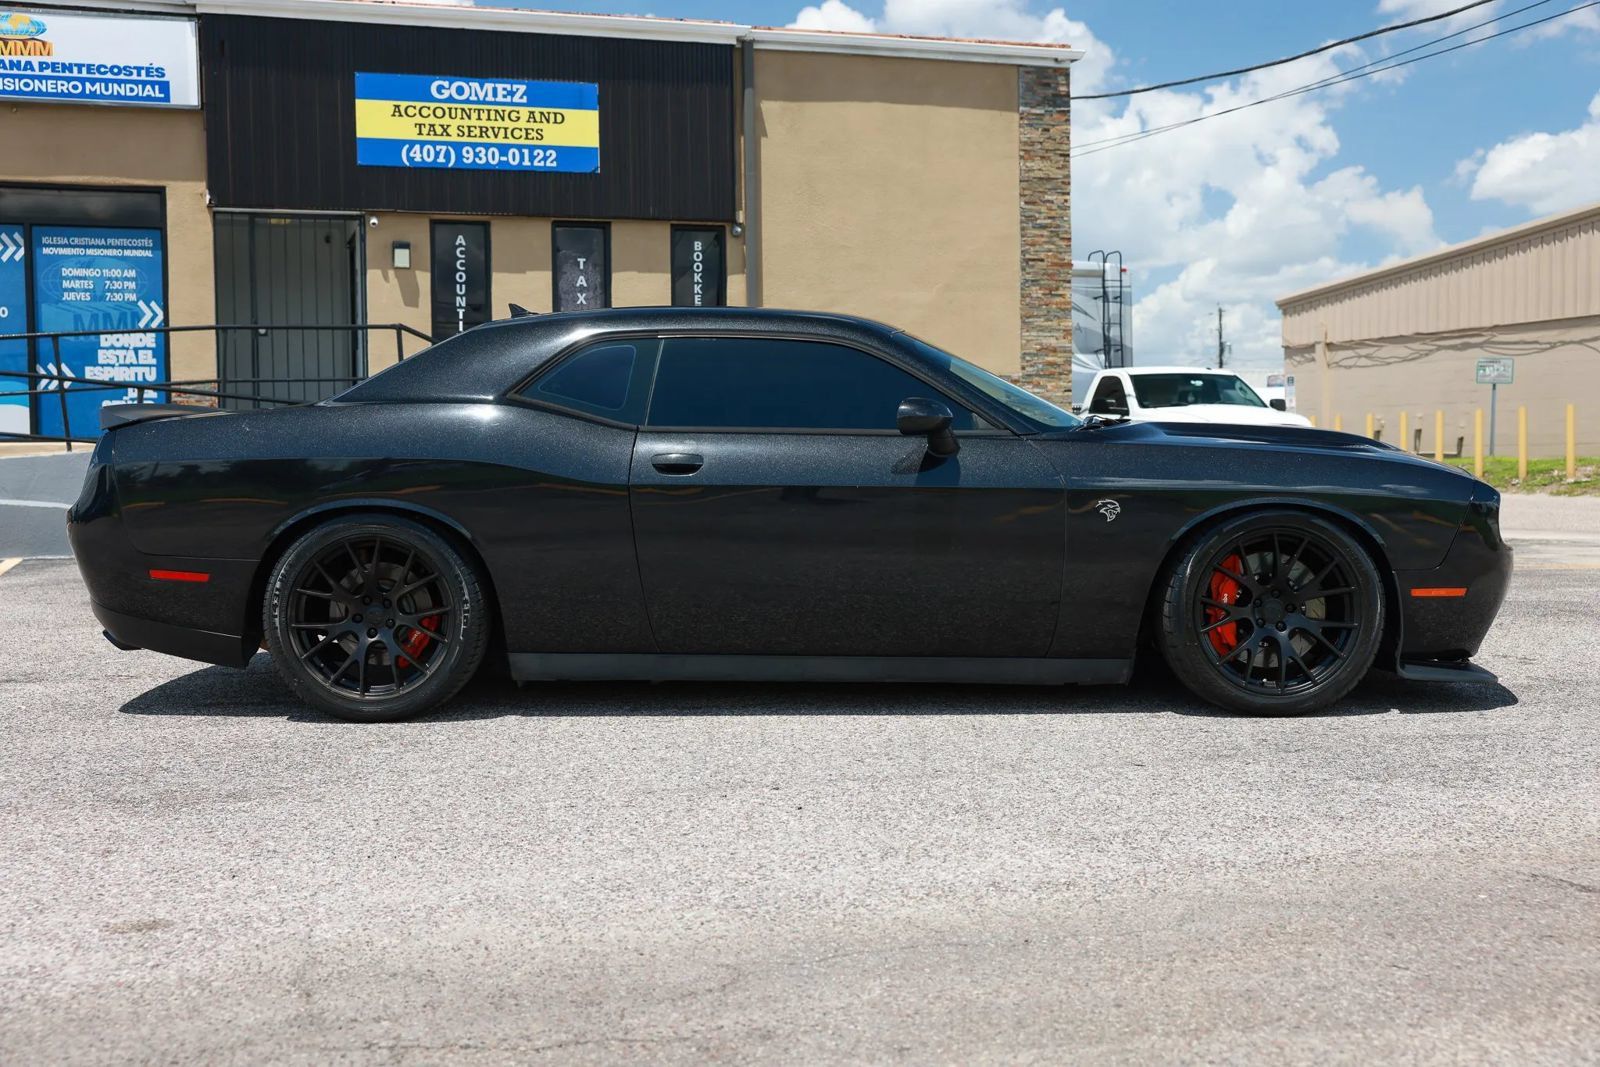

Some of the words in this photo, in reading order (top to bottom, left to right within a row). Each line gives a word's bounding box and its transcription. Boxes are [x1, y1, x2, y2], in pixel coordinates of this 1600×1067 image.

[38, 61, 166, 78] PENTECOSTÉS
[85, 82, 165, 98] MUNDIAL
[430, 80, 528, 103] GOMEZ
[391, 104, 521, 123] ACCOUNTING
[526, 110, 565, 125] AND
[414, 123, 452, 137] TAX
[456, 125, 545, 142] SERVICES
[400, 144, 456, 168] (407)
[462, 146, 557, 167] 930-0122
[42, 237, 69, 246] IGLESIA
[69, 238, 106, 246] CRISTIANA
[107, 238, 153, 247] PENTECOSTÉS
[42, 247, 85, 256] MOVIMIENTO
[86, 248, 122, 257] MISIONERO
[123, 249, 153, 257] MUNDIAL
[61, 267, 101, 277] DOMINGO
[102, 268, 121, 277] 11:00
[123, 269, 136, 278] AM
[62, 280, 94, 289] MARTES
[104, 280, 122, 290] 7:30
[124, 281, 136, 290] PM
[576, 258, 588, 305] TAX
[62, 292, 91, 301] JUEVES
[105, 292, 123, 301] 7:30
[124, 293, 137, 302] PM
[100, 332, 156, 348] DONDE
